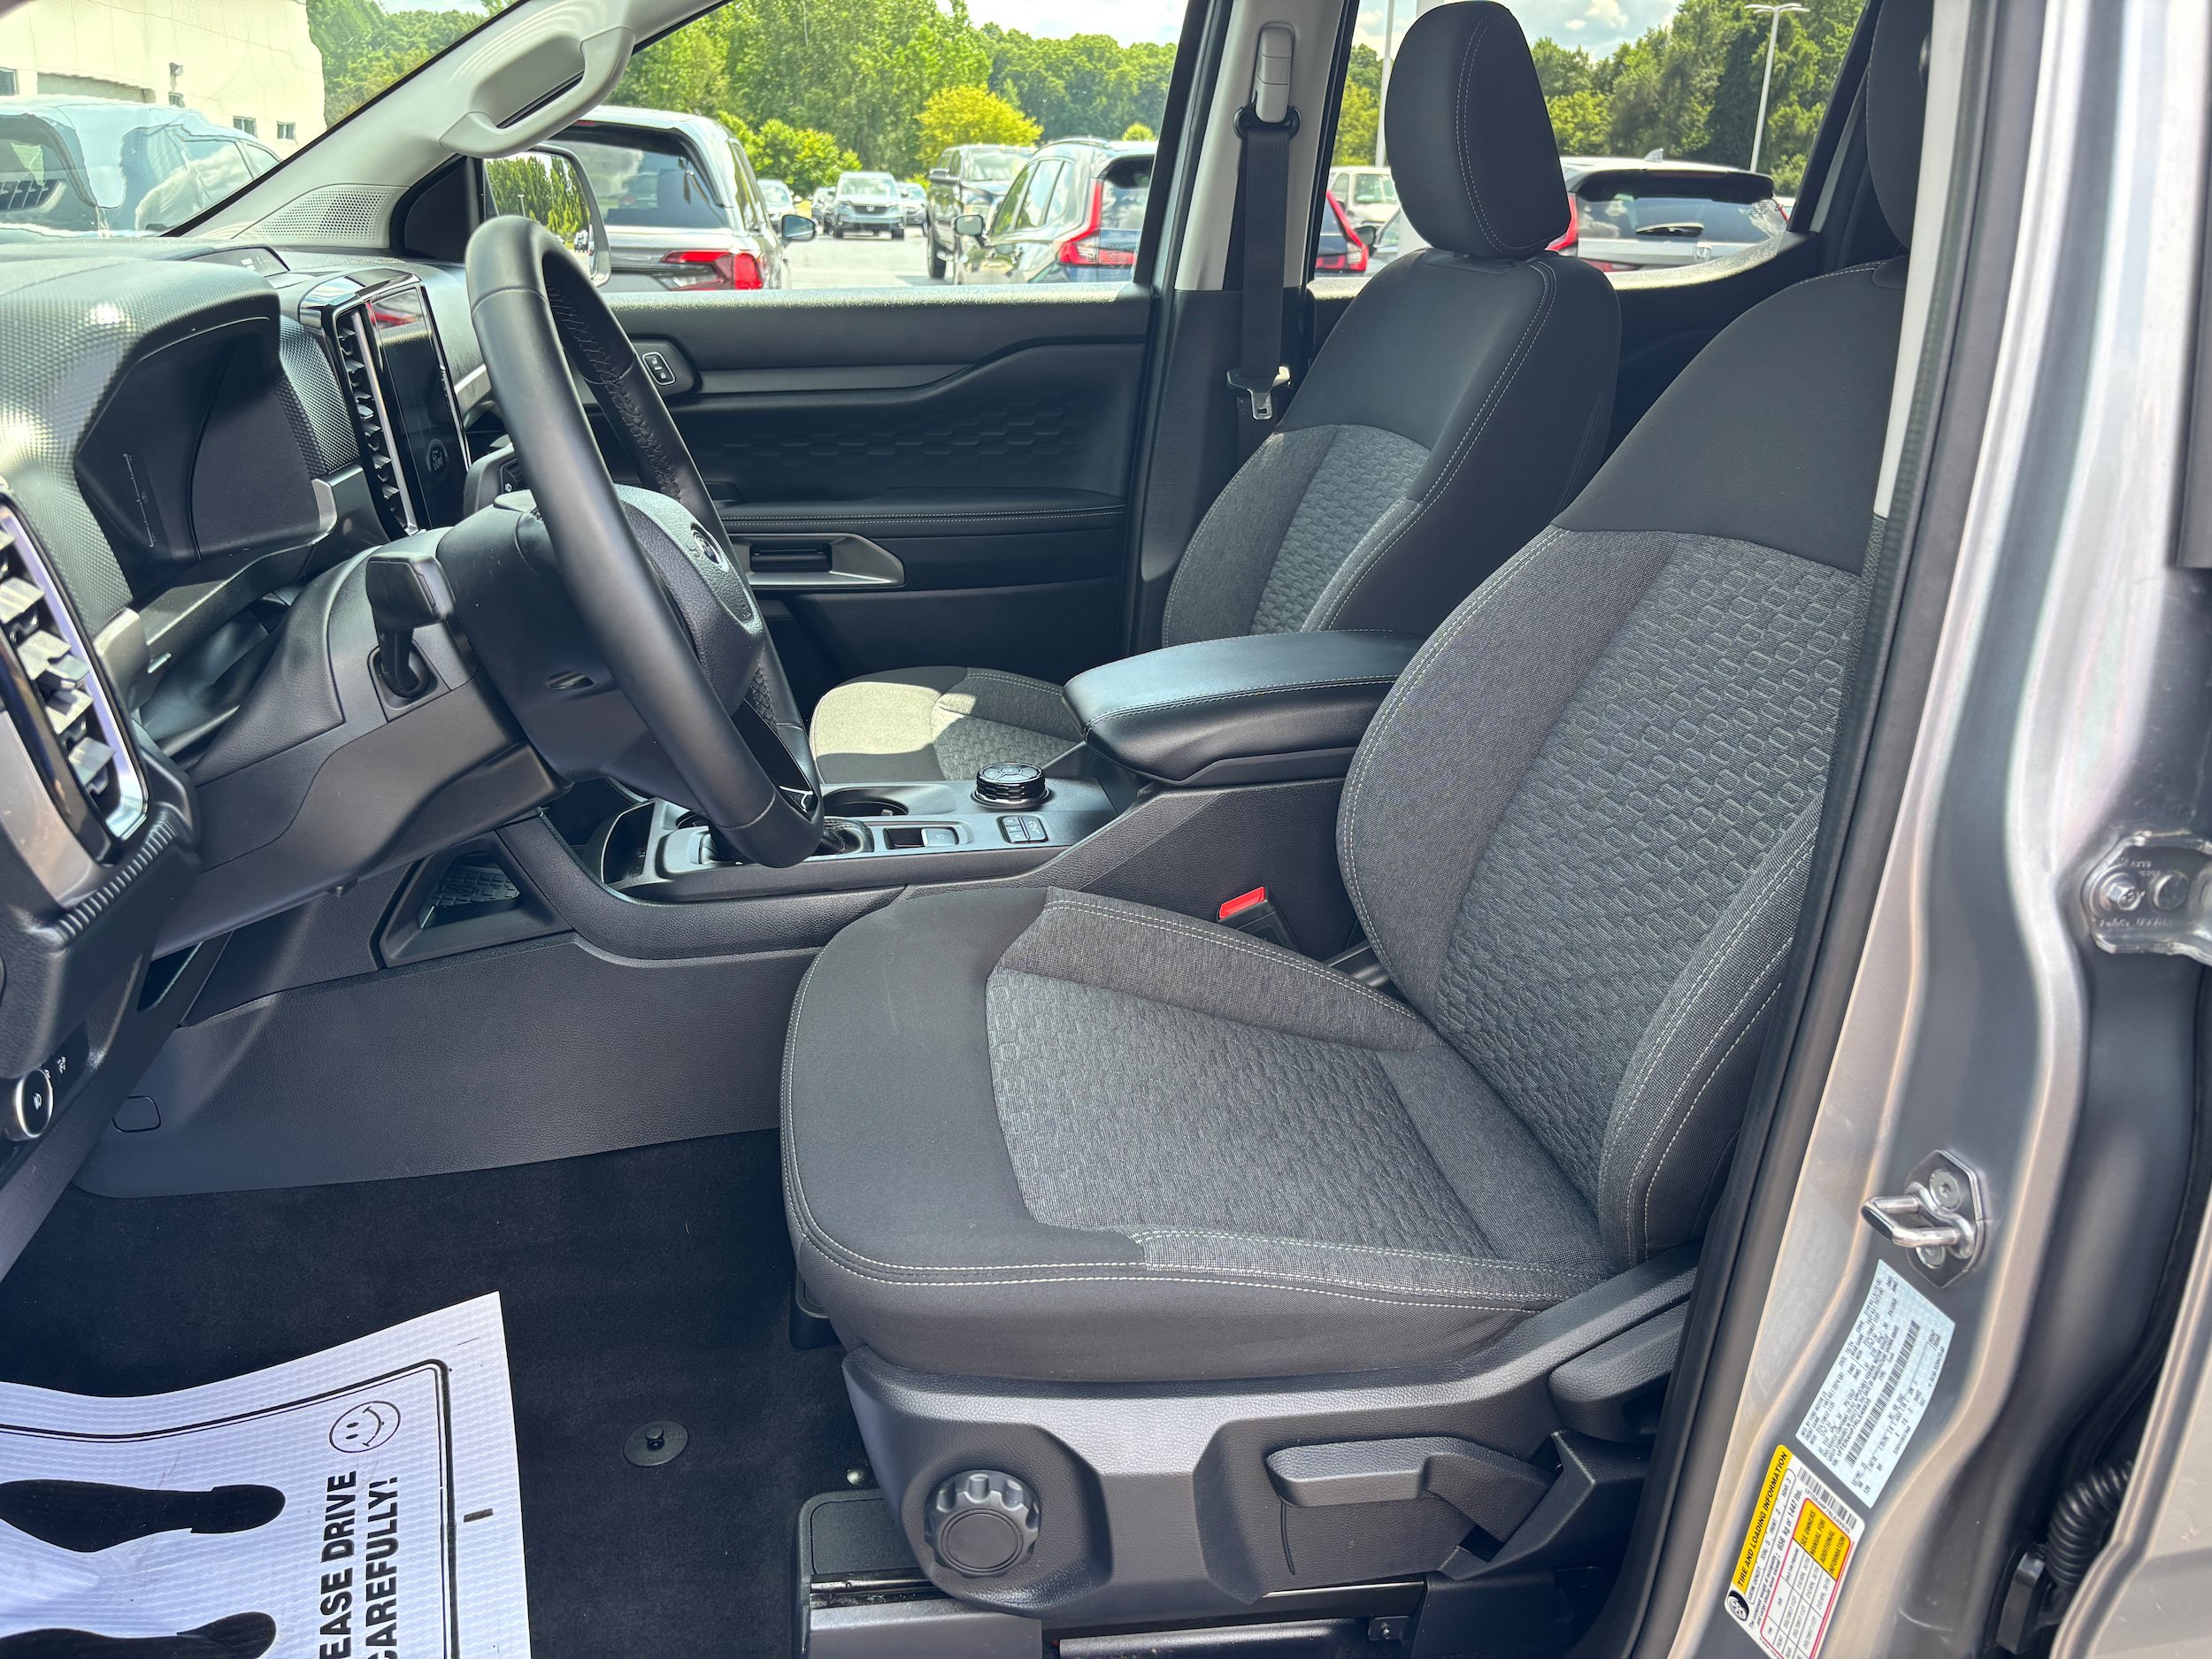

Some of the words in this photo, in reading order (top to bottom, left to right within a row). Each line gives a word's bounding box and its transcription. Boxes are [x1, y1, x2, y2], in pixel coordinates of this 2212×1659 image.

[1786, 1498, 1798, 1518] 1447
[1793, 1486, 1802, 1502] lbs.
[322, 1471, 357, 1563] DRIVE
[1737, 1565, 1748, 1587] TIRE
[1743, 1547, 1754, 1568] AND
[1749, 1509, 1767, 1549] LOADING
[1762, 1449, 1787, 1512] INFORMATION
[1780, 1524, 1790, 1538] kg
[1785, 1517, 1792, 1527] or
[1799, 1532, 1808, 1548] SEE
[1808, 1529, 1822, 1556] MANUAL
[1816, 1517, 1826, 1532] FOR
[1818, 1527, 1835, 1564] ADDITIONAL
[1827, 1533, 1847, 1576] INFORMATION
